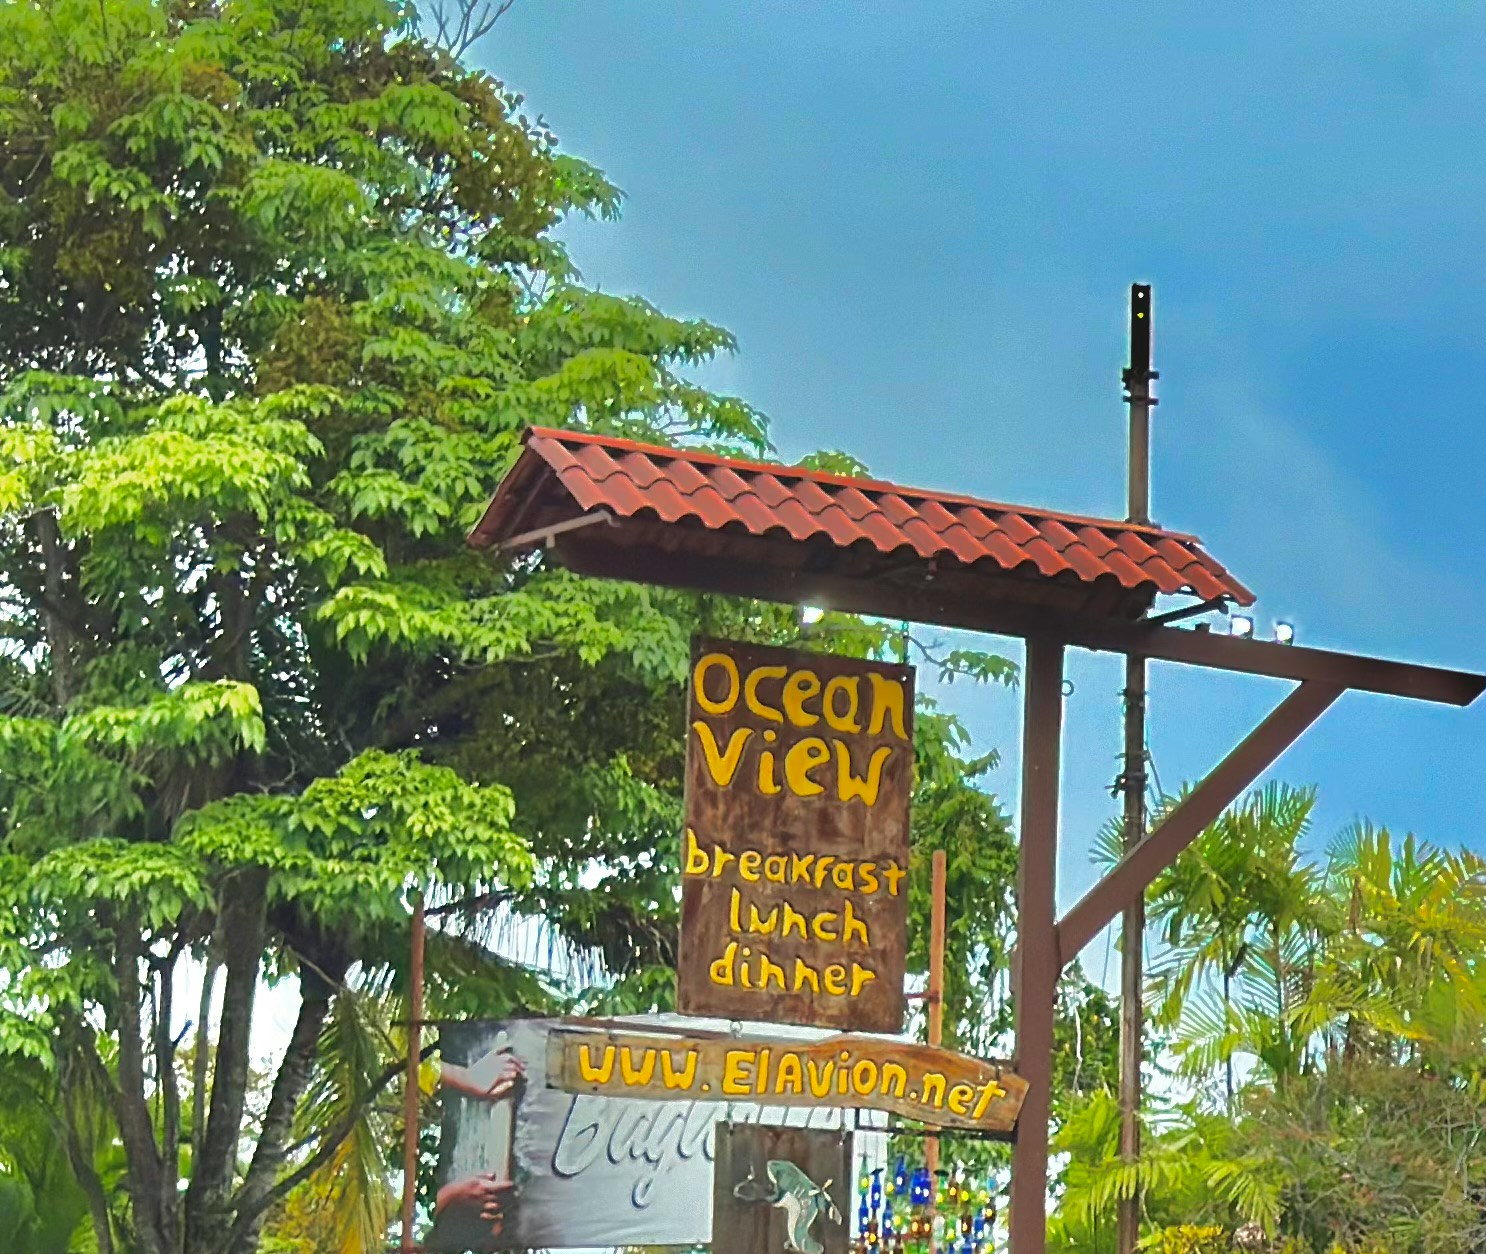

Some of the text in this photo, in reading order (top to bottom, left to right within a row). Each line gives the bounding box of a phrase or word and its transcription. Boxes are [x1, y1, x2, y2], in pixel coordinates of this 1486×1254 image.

[693, 653, 908, 740] Ocean
[693, 721, 892, 806] View
[685, 829, 906, 895] breakfast
[730, 887, 870, 946] lunch
[710, 942, 876, 997] dinner
